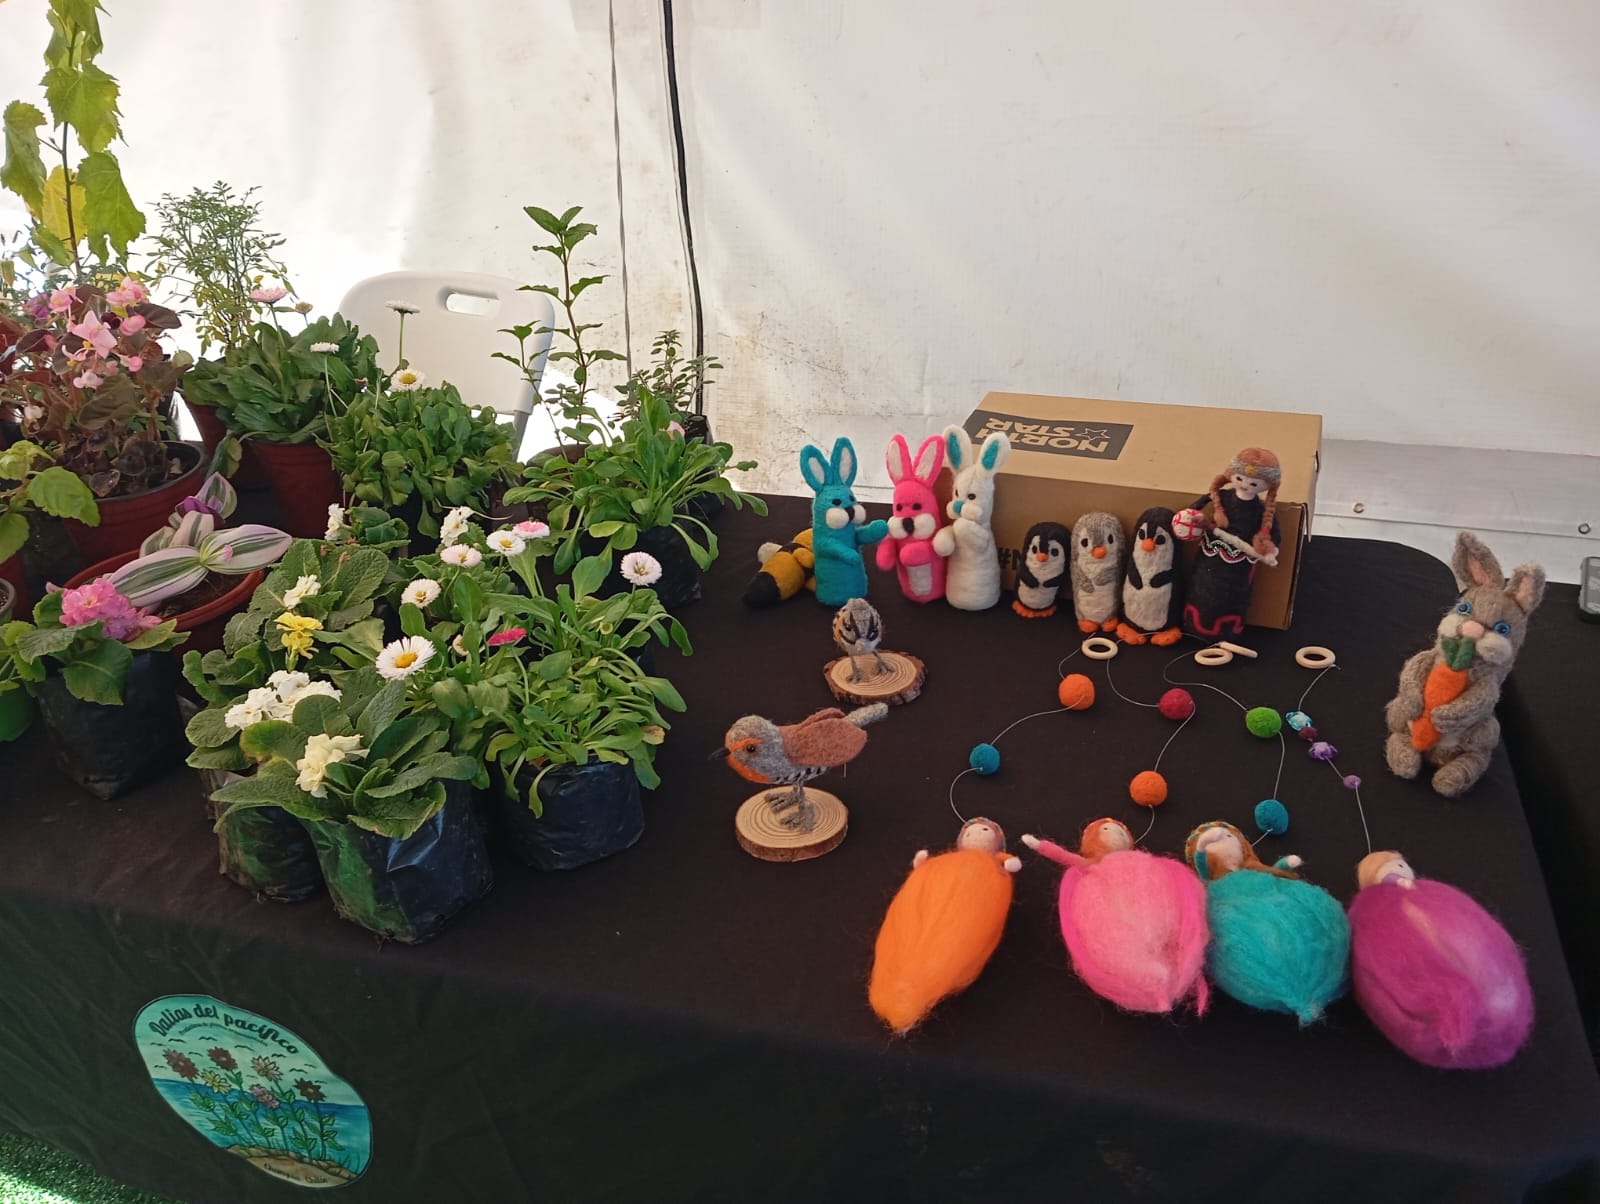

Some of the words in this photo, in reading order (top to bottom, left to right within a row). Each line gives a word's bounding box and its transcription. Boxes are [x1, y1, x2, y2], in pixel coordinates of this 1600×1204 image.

[985, 419, 1074, 437] STAR
[149, 1008, 192, 1036] Dalias
[193, 1003, 220, 1020] del
